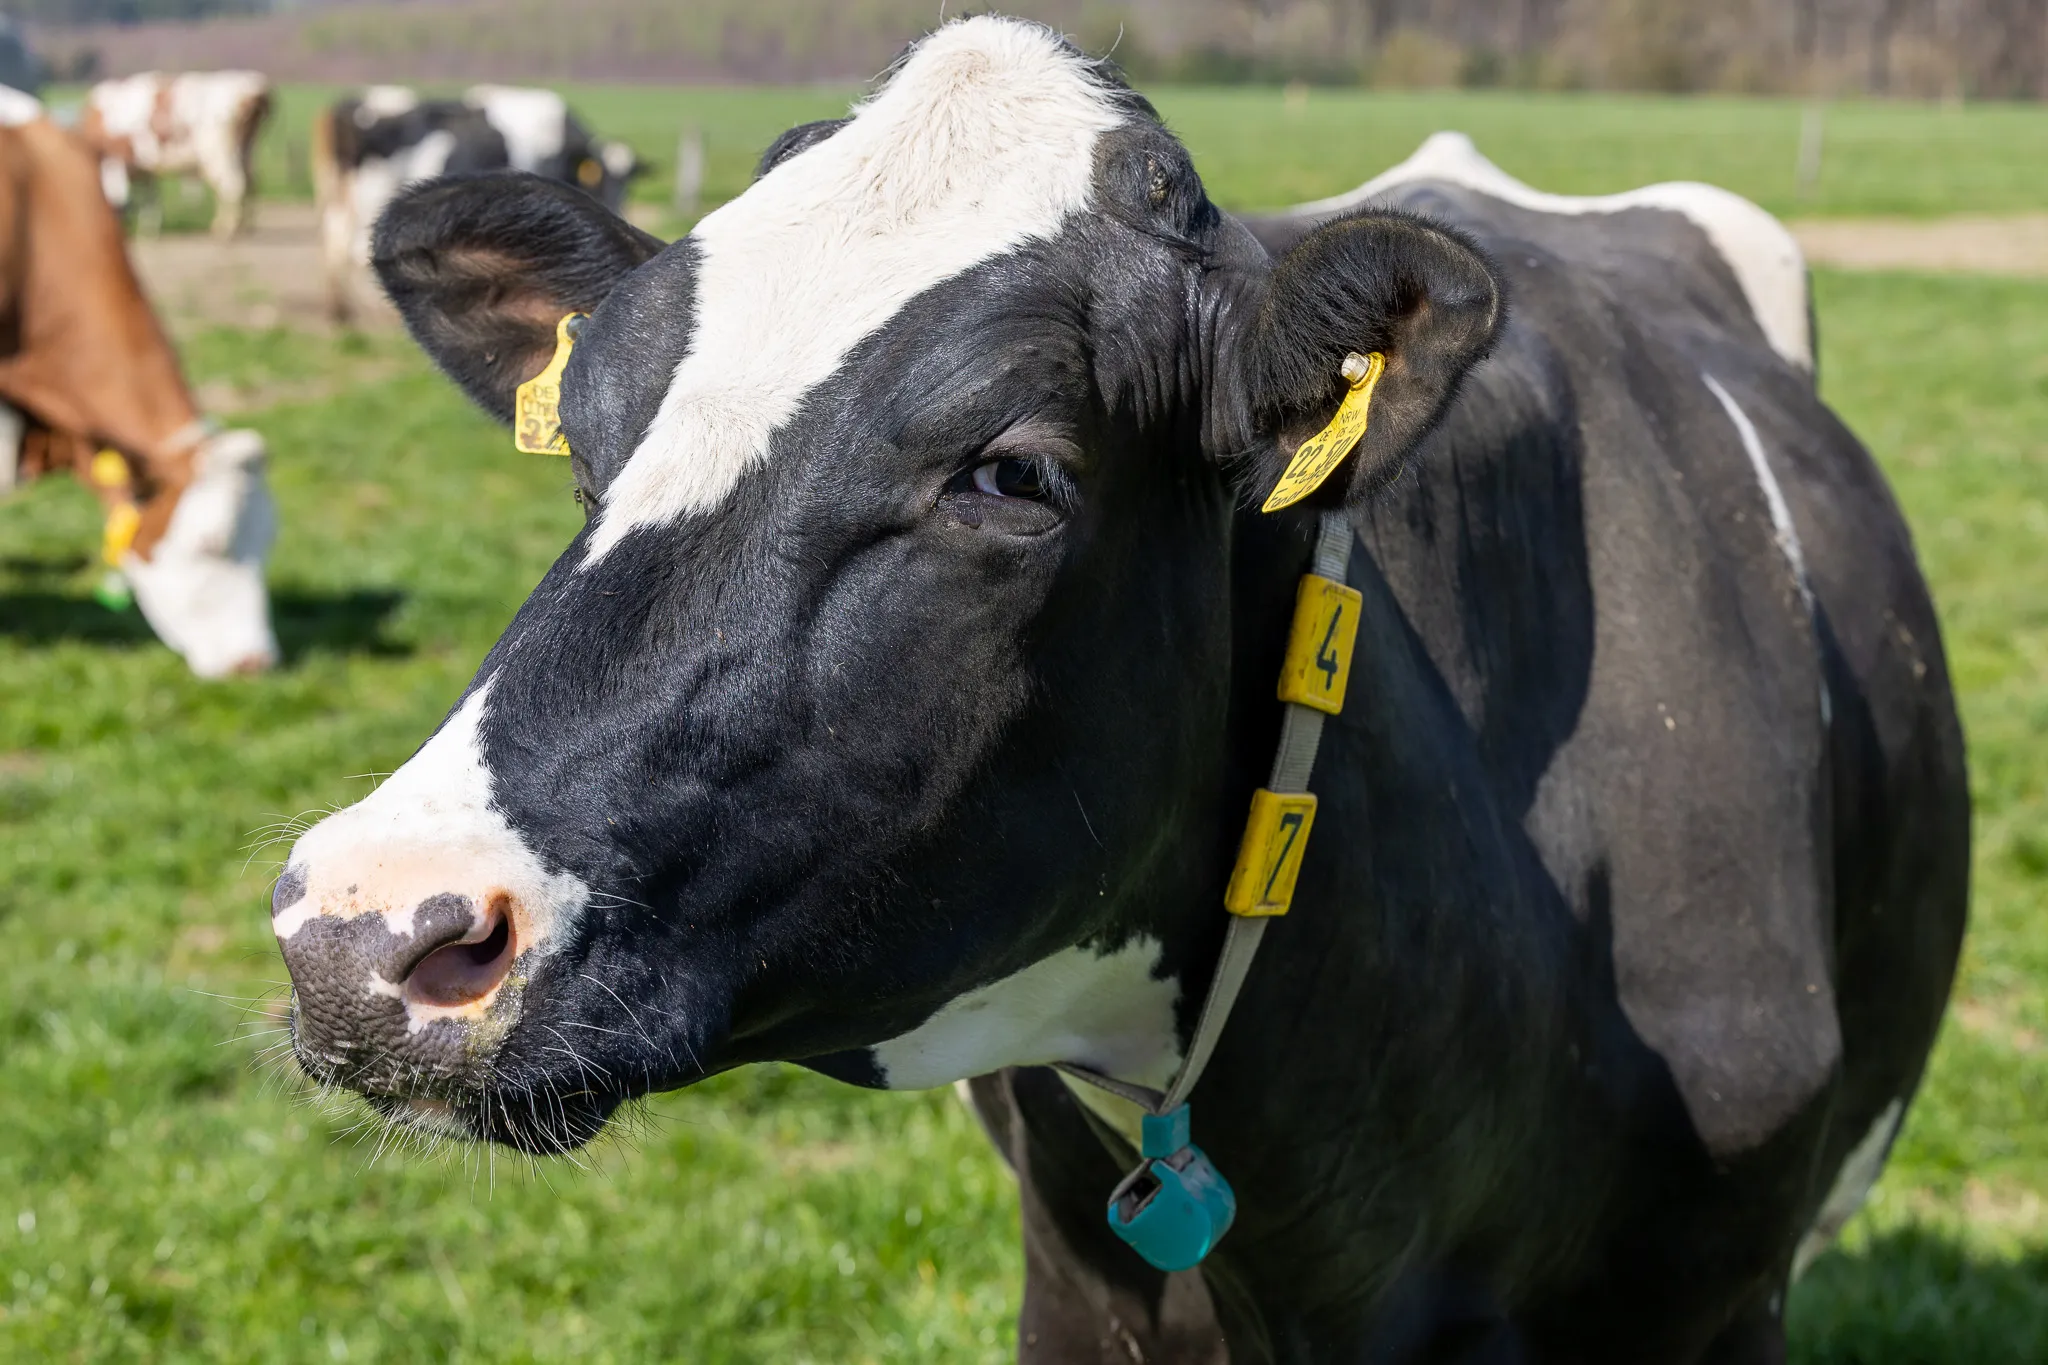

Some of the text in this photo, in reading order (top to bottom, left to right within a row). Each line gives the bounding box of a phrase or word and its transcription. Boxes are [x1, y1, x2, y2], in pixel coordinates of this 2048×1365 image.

[1286, 445, 1324, 479] 22
[1316, 603, 1343, 691] 4
[1264, 812, 1304, 901] 7
